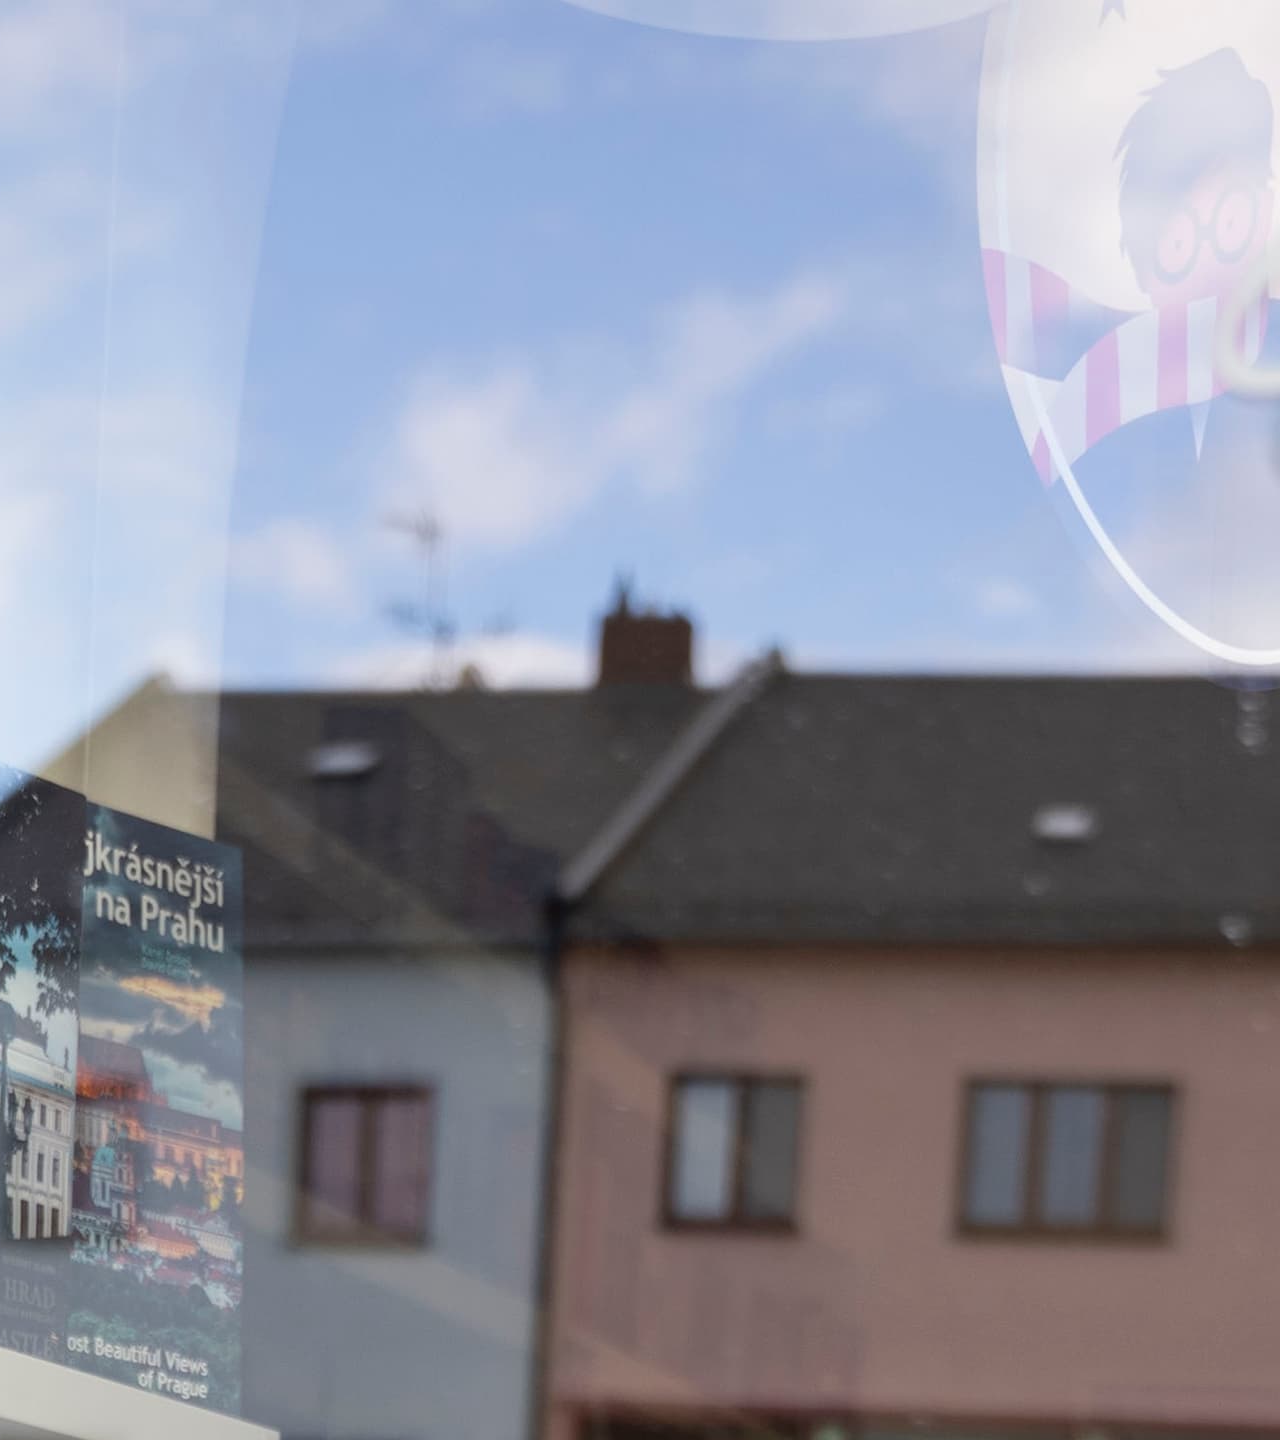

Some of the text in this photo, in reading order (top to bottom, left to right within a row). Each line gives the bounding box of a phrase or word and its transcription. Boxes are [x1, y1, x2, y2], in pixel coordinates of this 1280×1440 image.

[95, 883, 224, 954] na Prahu
[66, 1334, 209, 1377] ost Beautiful Views
[138, 1369, 208, 1399] of Prague
